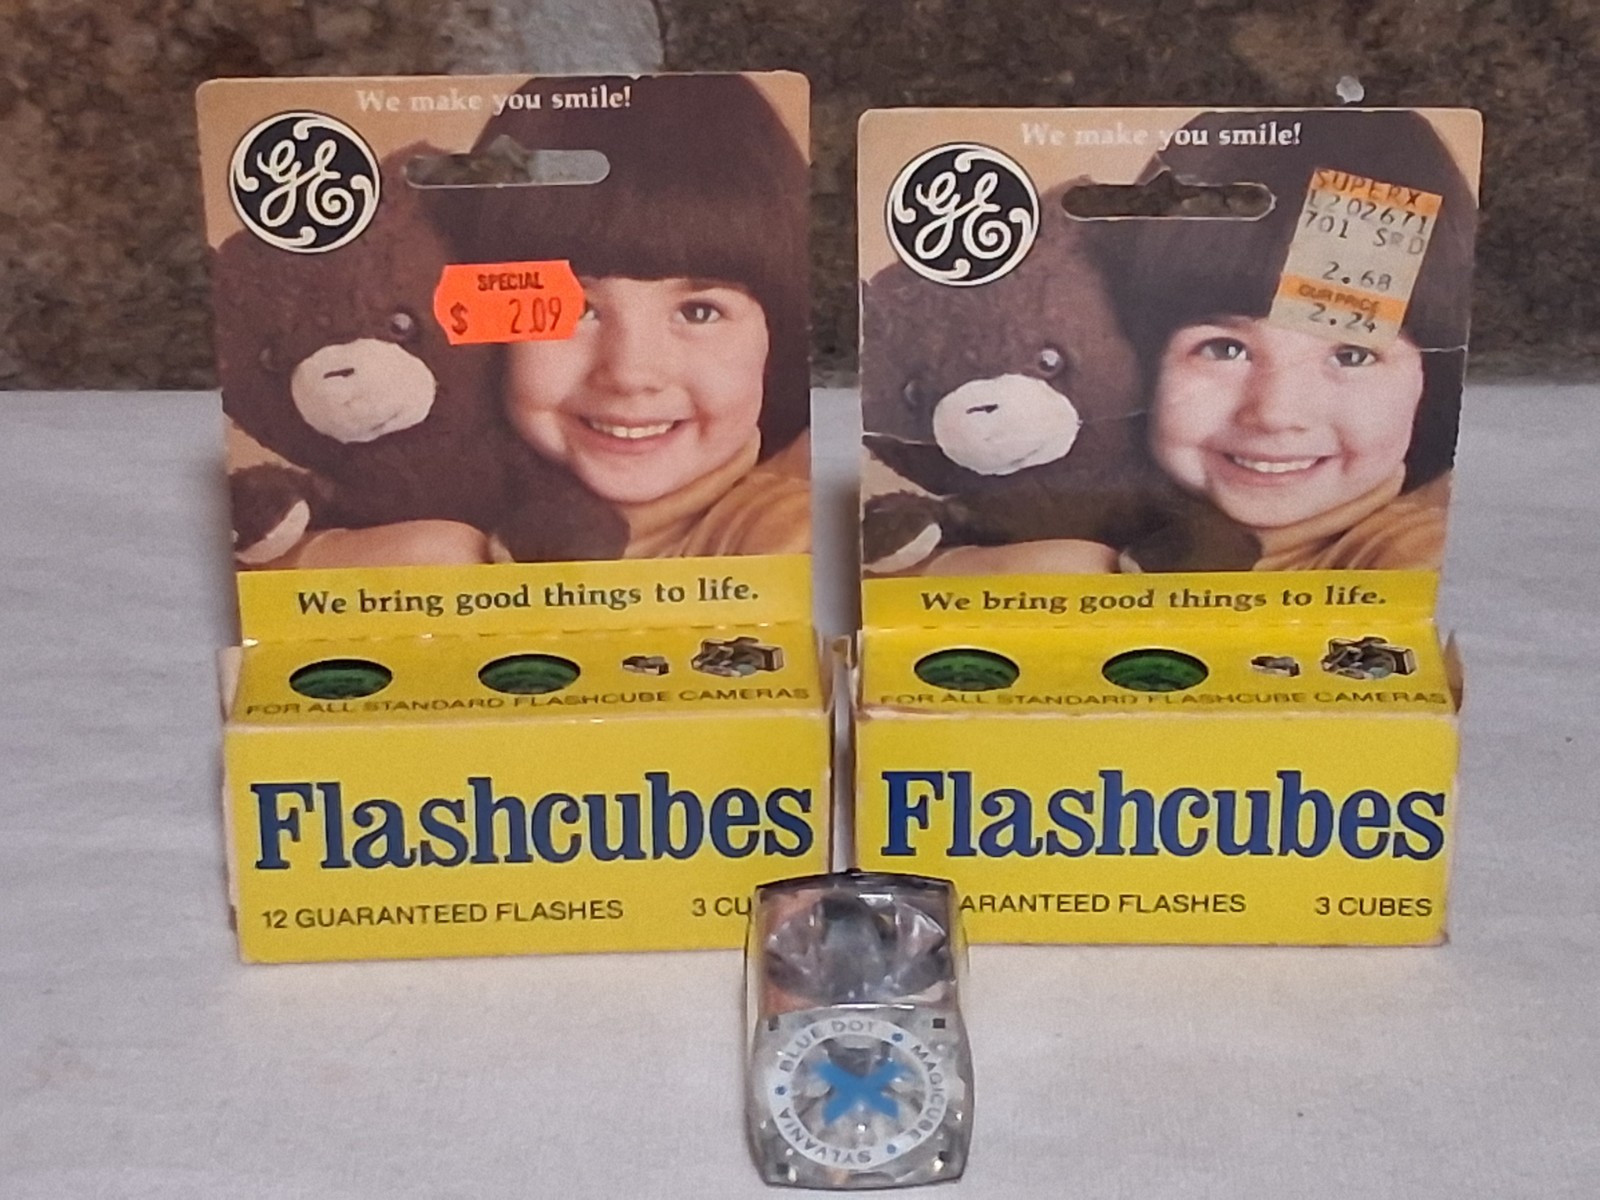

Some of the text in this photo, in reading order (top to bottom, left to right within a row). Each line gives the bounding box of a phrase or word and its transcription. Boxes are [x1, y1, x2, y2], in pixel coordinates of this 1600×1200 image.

[357, 85, 632, 116] We make you smile!
[1021, 121, 1303, 151] We make you smile!
[1304, 210, 1350, 239] 701
[478, 272, 544, 292] SPECIAL
[1322, 261, 1392, 292] 2.68
[450, 298, 563, 335] $ 2.09
[1308, 302, 1377, 333] 2.24
[297, 577, 760, 617] We bring good things to life.
[922, 584, 1387, 613] We bring good things to life.
[246, 687, 811, 716] FOR ALL STANDARD FLASHCUBE CAMERAS
[880, 690, 1447, 706] FOR ALL STANDARD FLASHCUBE CAMERAS
[250, 771, 815, 870] Flashcubes
[880, 769, 1445, 861] Flashcubes
[262, 899, 625, 930] 12 GUARANTEED FLASHES
[692, 899, 708, 917] 3
[959, 893, 1247, 914] ARANTEED FLASHES
[1315, 895, 1433, 917] 3 CUBES
[831, 1020, 875, 1033] DOT
[777, 1106, 873, 1165] SYLVANIA
